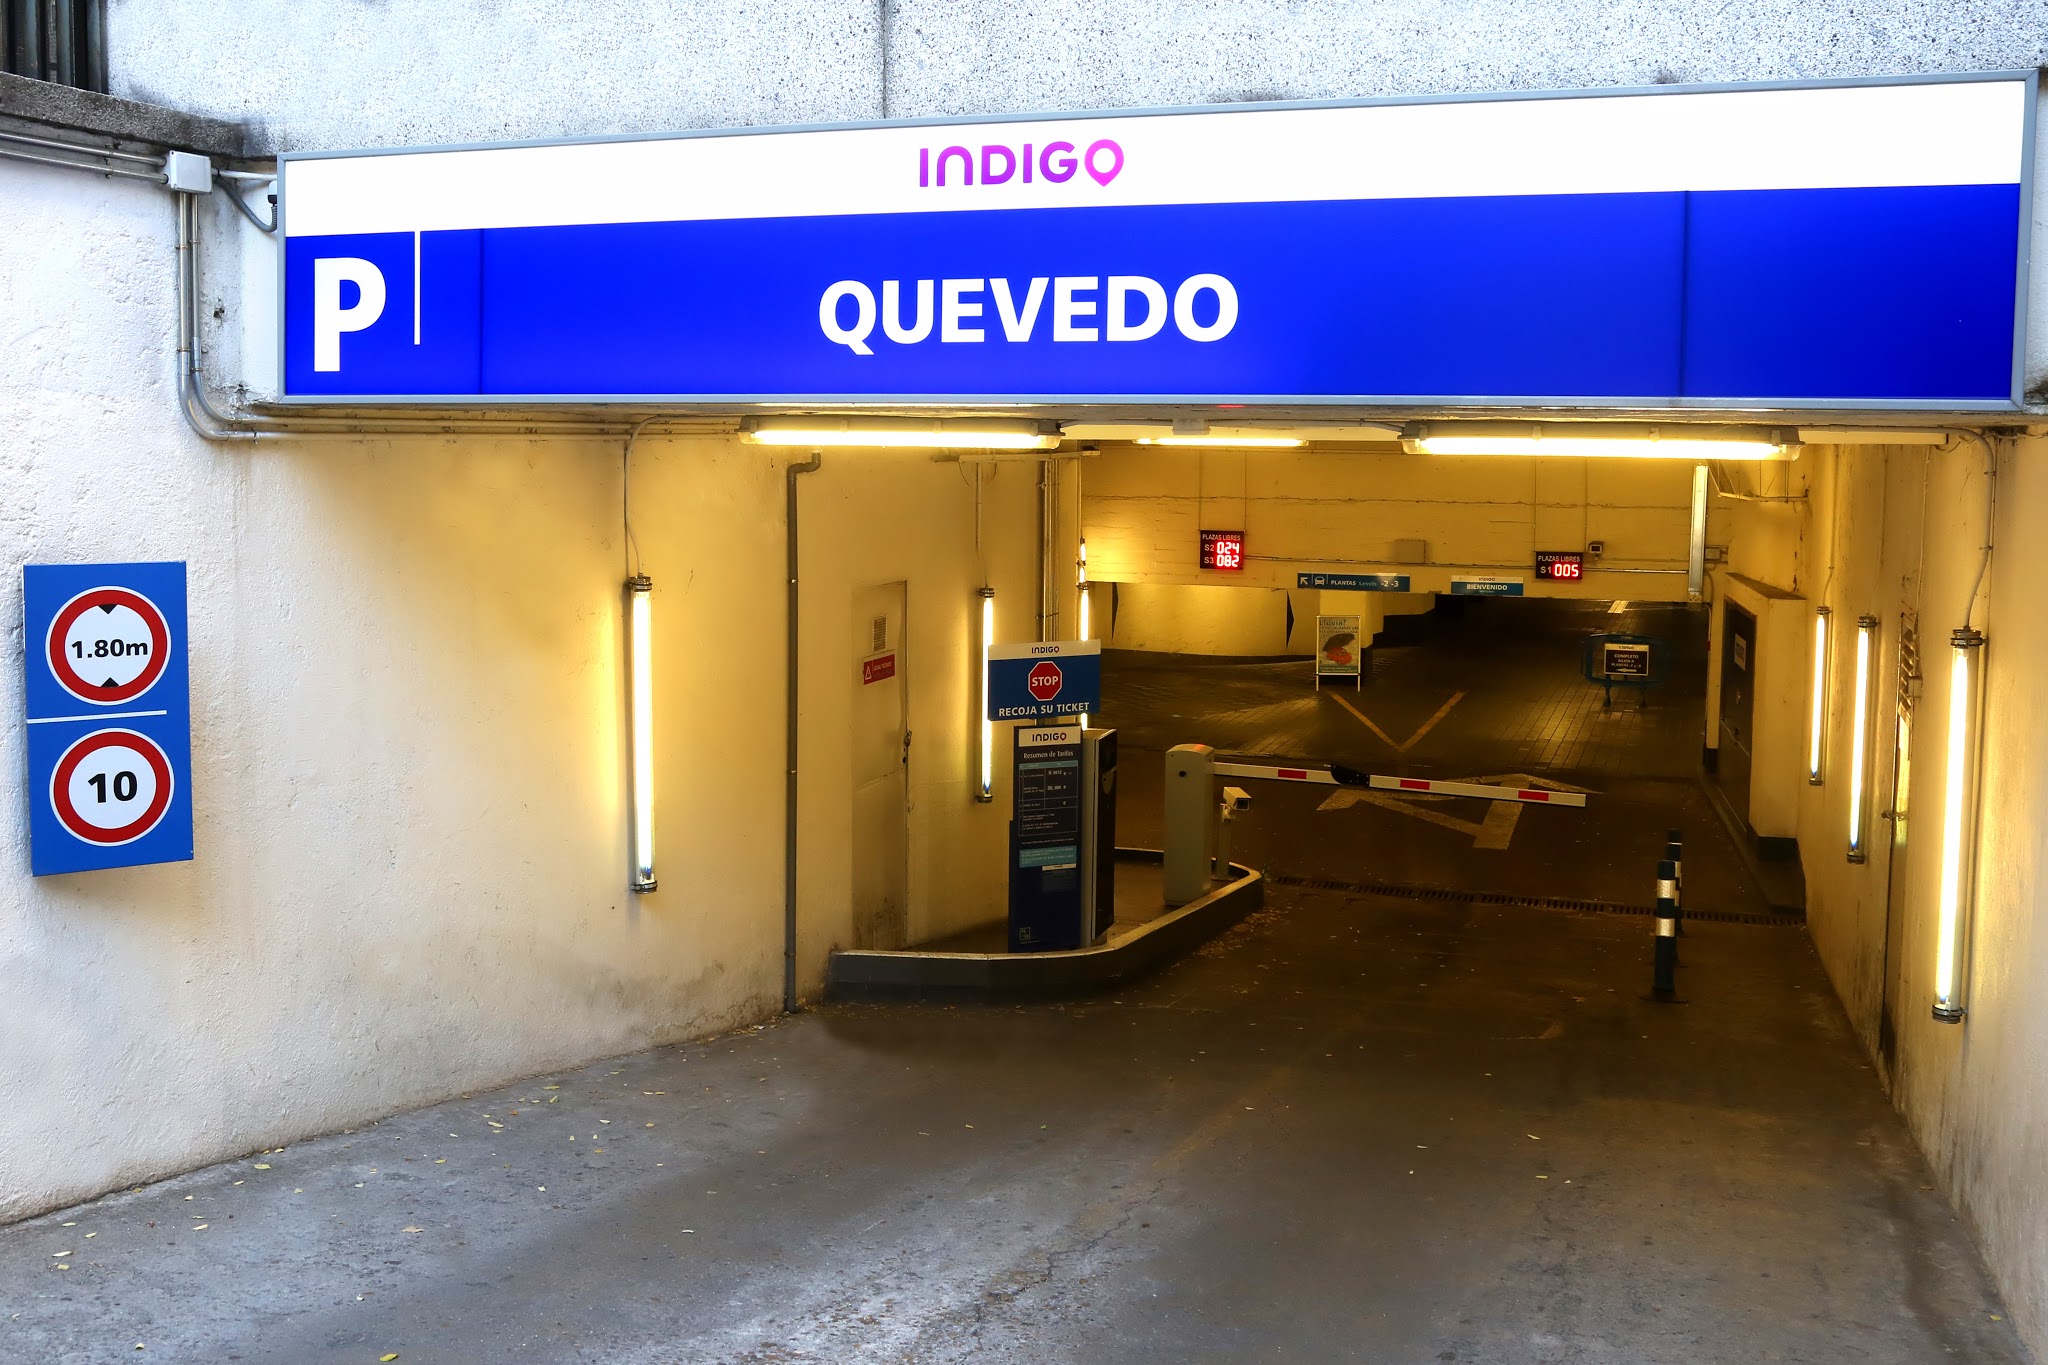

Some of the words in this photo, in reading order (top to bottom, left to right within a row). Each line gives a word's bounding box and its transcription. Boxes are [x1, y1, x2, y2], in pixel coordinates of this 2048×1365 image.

[919, 139, 1124, 187] INDIGO
[314, 257, 387, 372] P
[819, 273, 1239, 355] QUEVEDO
[1202, 533, 1221, 541] PLAZAS
[1222, 534, 1241, 542] LIBRES
[1204, 543, 1215, 552] S2
[1216, 541, 1240, 554] 024
[1203, 556, 1215, 564] S3
[1216, 554, 1240, 567] 082
[1554, 563, 1579, 577] 005
[1466, 583, 1508, 591] BIENVENIDO
[71, 638, 148, 659] 1.80m
[1031, 645, 1060, 654] INDIGO
[1031, 675, 1059, 687] STOP
[998, 705, 1037, 717] RECOJA
[1040, 704, 1054, 714] SU
[1056, 702, 1090, 713] TICKET
[1032, 732, 1067, 742] INDIGO
[1023, 751, 1048, 759] Resumen
[1057, 749, 1074, 757] Tarifas
[88, 770, 138, 803] 10
